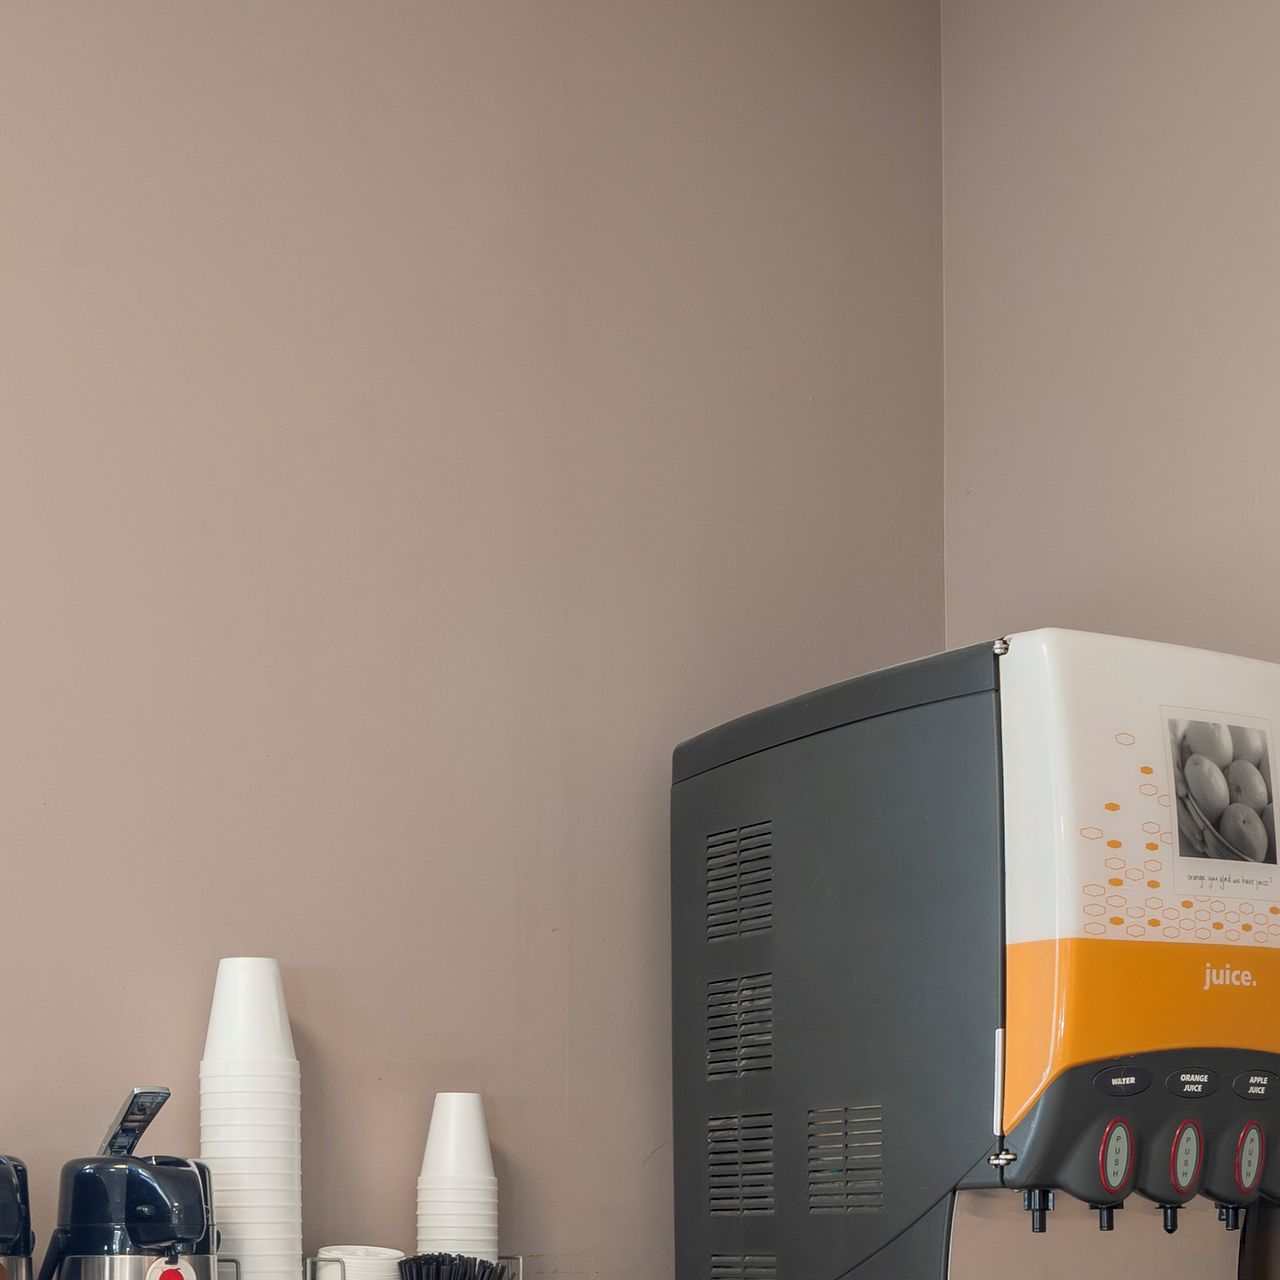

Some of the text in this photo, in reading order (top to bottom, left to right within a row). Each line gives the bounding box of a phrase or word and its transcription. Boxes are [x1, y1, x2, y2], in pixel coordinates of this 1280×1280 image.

[1203, 962, 1256, 990] juice.
[1111, 1076, 1136, 1086] WATER
[1180, 1074, 1208, 1082] ORANGE
[1249, 1076, 1268, 1084] APPLE
[1183, 1084, 1202, 1092] JUICE
[1248, 1086, 1266, 1094] JUICE
[1113, 1135, 1121, 1177] PUSH
[1183, 1136, 1191, 1177] PUSH
[1246, 1137, 1254, 1178] PUSH
